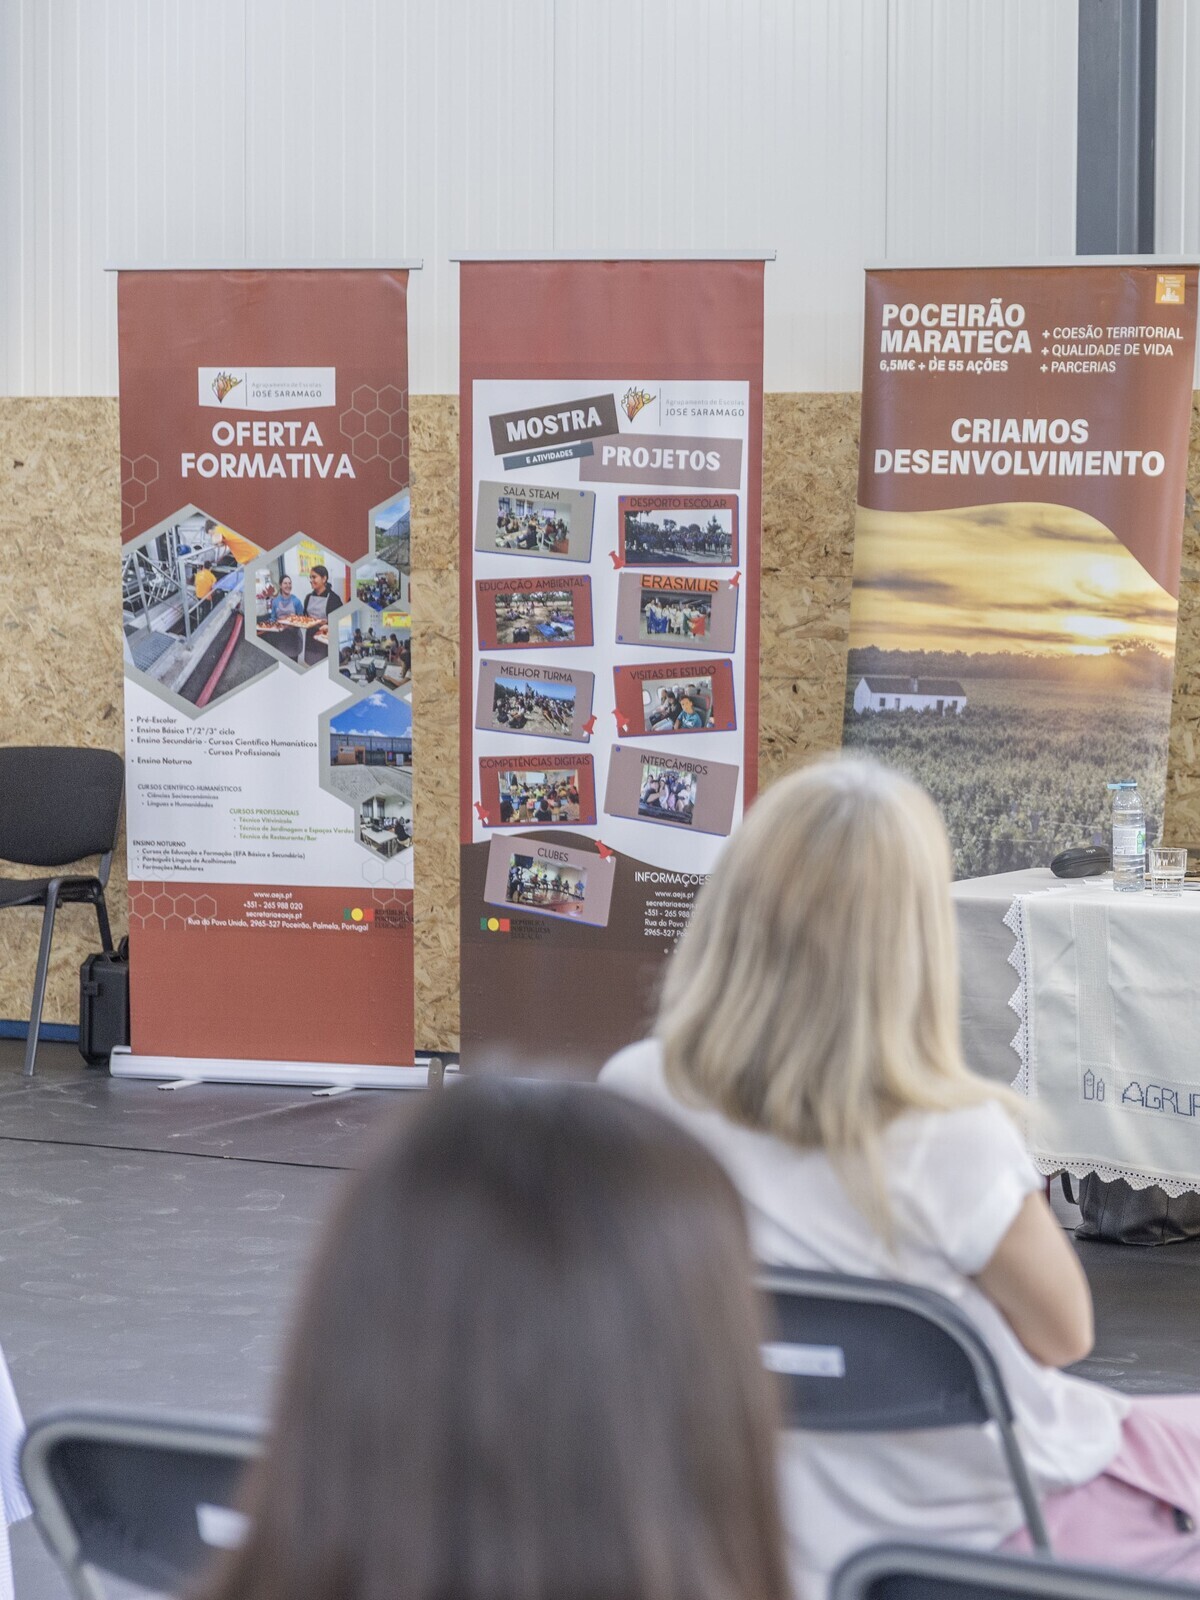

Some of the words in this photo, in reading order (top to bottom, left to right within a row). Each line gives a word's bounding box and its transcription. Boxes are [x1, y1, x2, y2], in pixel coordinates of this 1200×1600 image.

[882, 298, 1026, 327] POCEIRÃO
[1042, 330, 1050, 339] +
[1053, 325, 1103, 340] COESÃO
[1106, 326, 1184, 339] TERRITORIAL
[881, 330, 1032, 353] MARATECA
[1041, 347, 1049, 355] +
[1052, 344, 1121, 357] QUALIDADE
[1124, 344, 1140, 355] DE
[1143, 344, 1174, 356] VIDA
[880, 359, 916, 373] 6,5M€
[929, 359, 945, 371] DE
[948, 360, 964, 371] 55
[966, 358, 1009, 375] AÇÕES
[1040, 364, 1048, 372] +
[1051, 361, 1116, 373] PARCERIAS
[252, 389, 272, 398] JOSÉ
[275, 390, 322, 398] SARAMAGO
[666, 407, 688, 416] JOSÉ
[691, 408, 745, 417] SARAMAGO
[506, 407, 602, 442] MOSTRA
[951, 418, 1089, 444] CRIAMOS
[212, 421, 323, 447] OFERTA
[532, 449, 574, 464] ATIVIDADES
[602, 446, 721, 471] PROJETOS
[874, 449, 1165, 477] DESENVOLVIMENTO
[181, 453, 356, 479] FORMATIVA
[503, 485, 527, 498] SALA
[529, 488, 560, 500] STEAM
[630, 497, 680, 508] DESPORTO
[683, 497, 727, 508] ESCOLAR
[479, 579, 533, 593] EDUCAÇÃO
[535, 579, 584, 591] AMBIENTAL
[641, 574, 719, 591] ERASMUS
[500, 666, 540, 680] MELHOR
[542, 670, 573, 683] TURMA
[630, 668, 664, 680] VISITAS
[666, 668, 678, 678] DE
[680, 666, 717, 677] ESTUDO
[136, 716, 177, 724] Pré-Escolar
[162, 727, 185, 735] Básico
[219, 728, 235, 736] ciclo
[162, 737, 203, 745] Secundário
[208, 738, 233, 746] Cursos
[235, 738, 269, 746] Científico
[271, 740, 317, 748] Humanísticos
[208, 748, 233, 756] Cursos
[235, 749, 281, 757] Profissionais
[162, 757, 192, 765] Noturno
[480, 757, 552, 769] COMPETÊNCIAS
[554, 756, 590, 767] DIGITAIS
[640, 754, 708, 775] INTERCÂMBIOS
[537, 847, 569, 863] CLUBES
[655, 891, 694, 900] www.aejs.pt
[263, 901, 276, 909] 265
[678, 910, 690, 918] 988
[188, 917, 200, 925] Rua
[211, 918, 227, 926] Povo
[342, 923, 369, 932] Portugal
